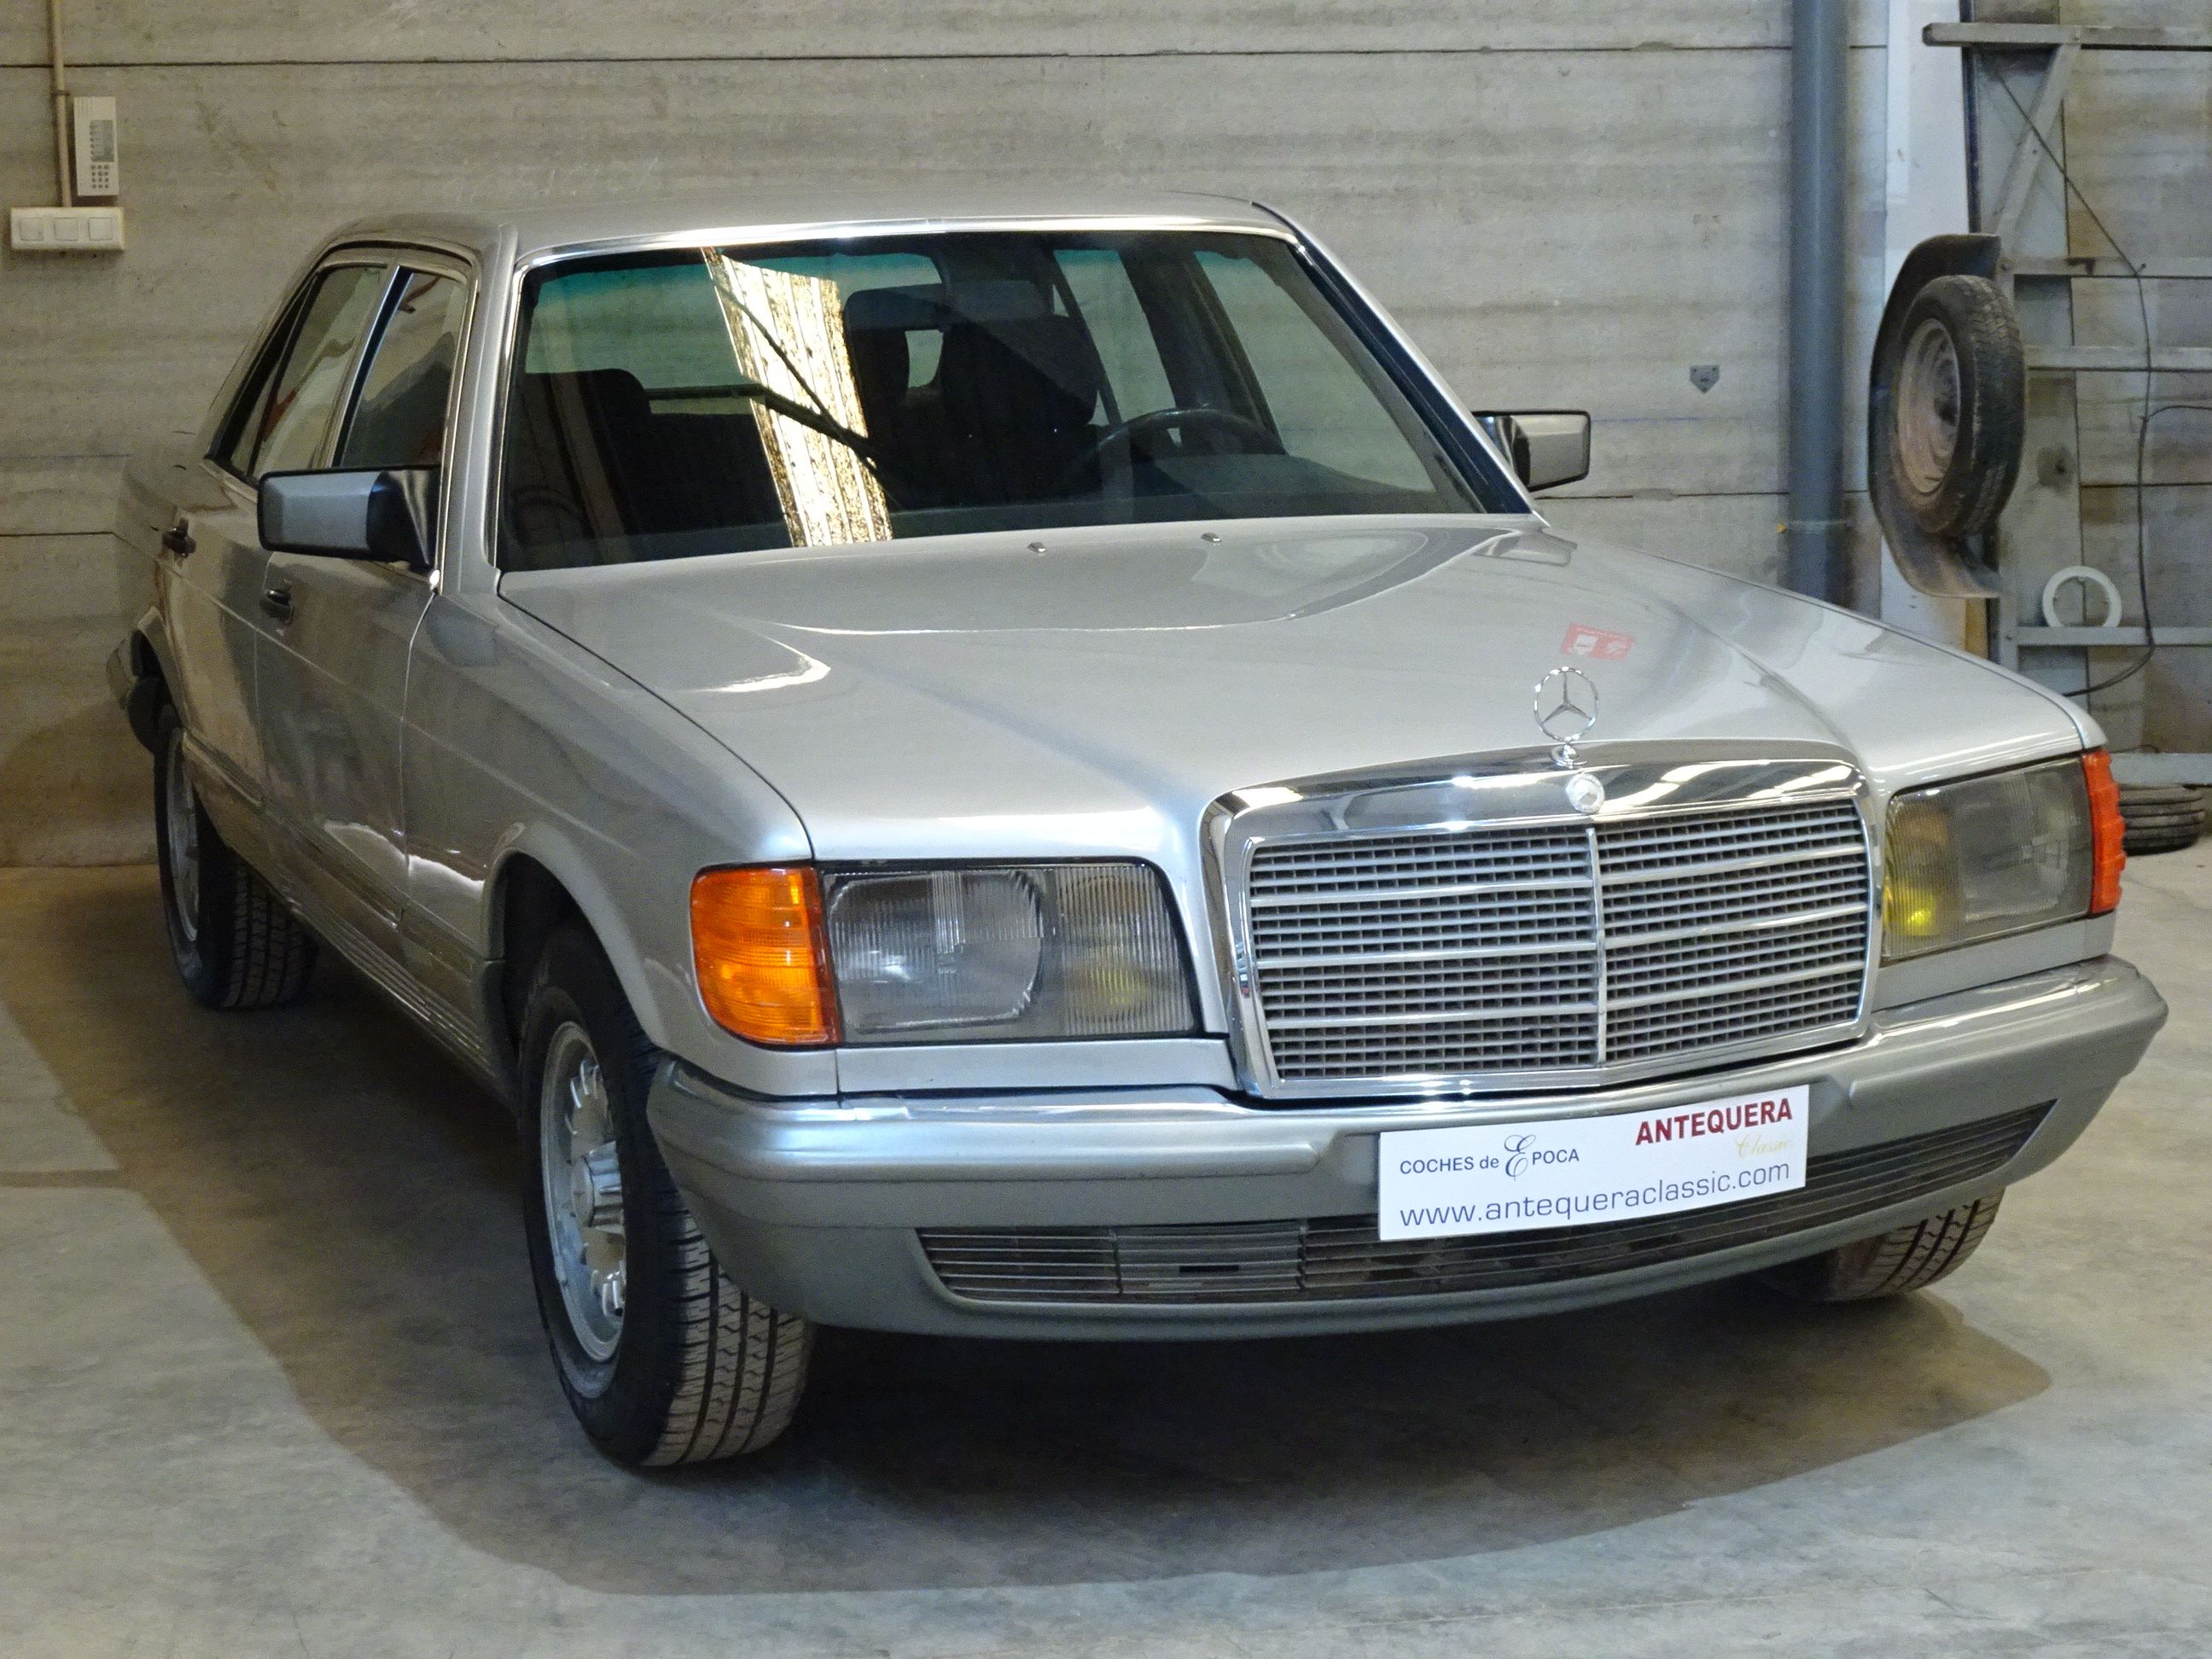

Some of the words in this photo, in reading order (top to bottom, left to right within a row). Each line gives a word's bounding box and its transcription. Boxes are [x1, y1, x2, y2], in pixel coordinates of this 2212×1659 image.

[1635, 1097, 1793, 1146] ANTEQUERA
[1400, 1156, 1475, 1174] COCHES
[1479, 1155, 1499, 1169] de
[1400, 1163, 1790, 1226] www.antequeraclassic.com
